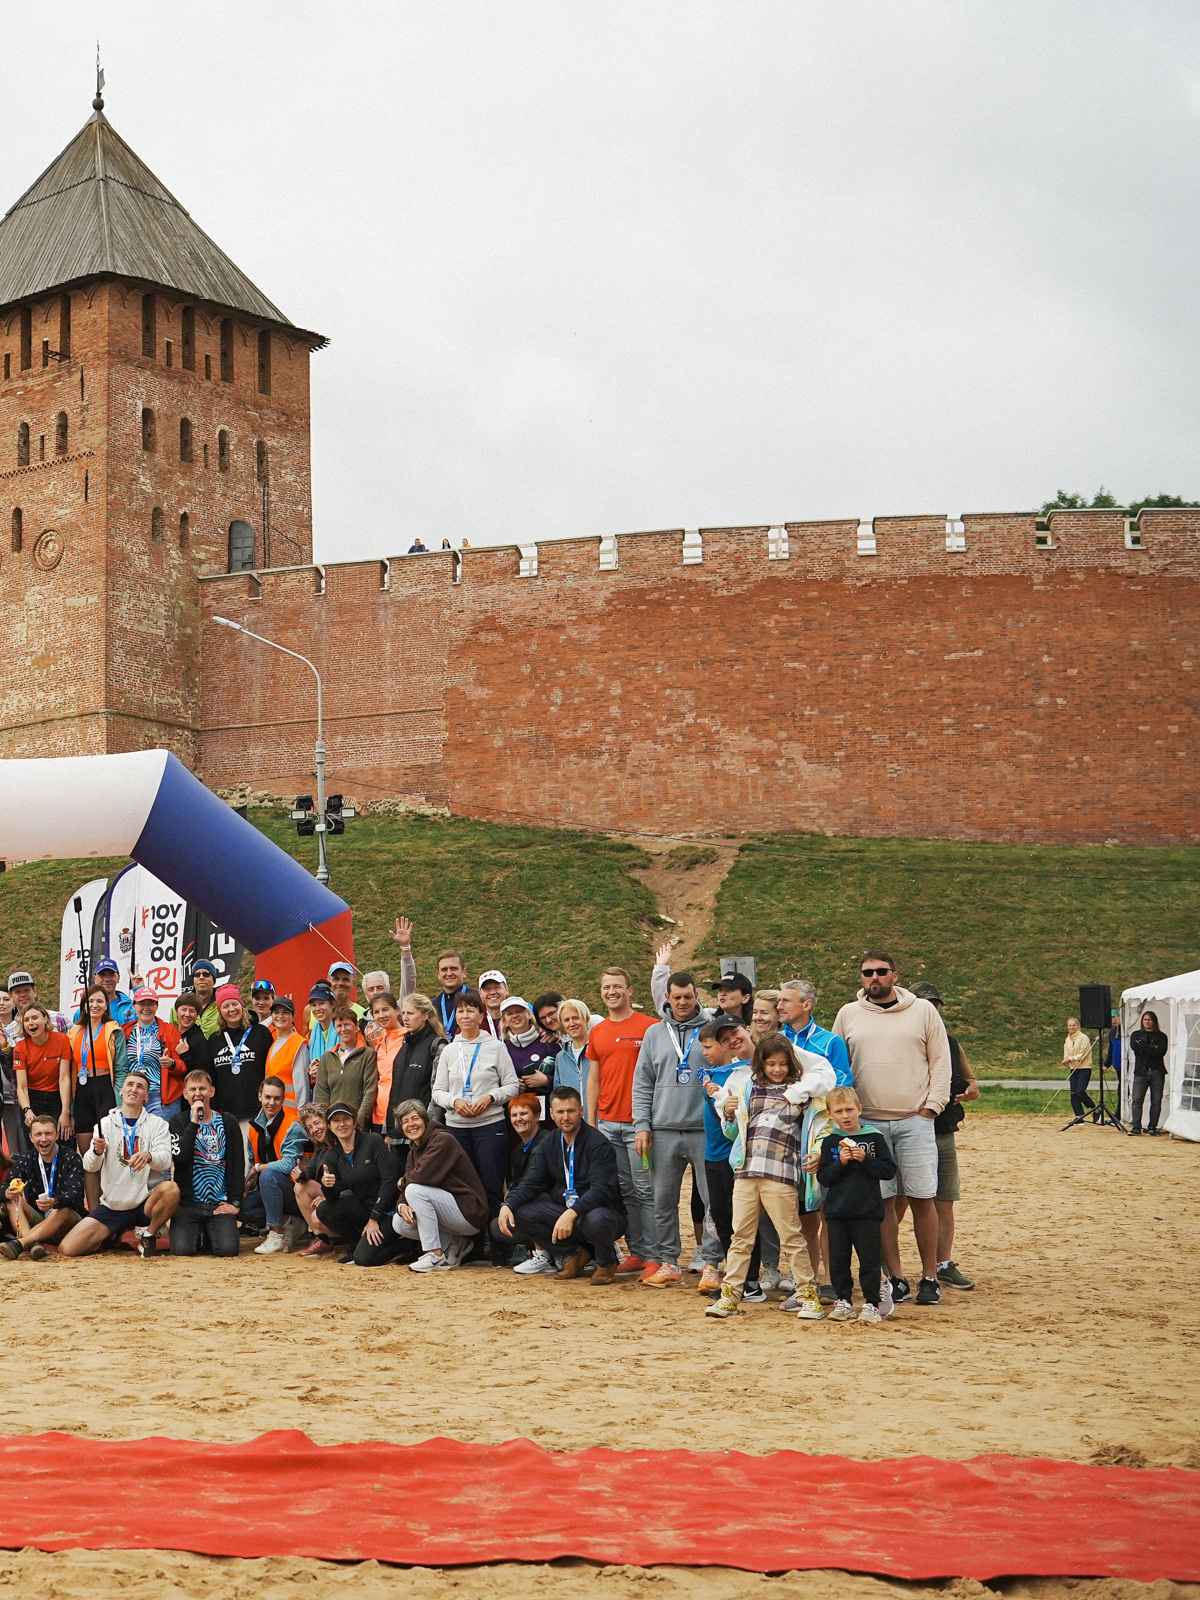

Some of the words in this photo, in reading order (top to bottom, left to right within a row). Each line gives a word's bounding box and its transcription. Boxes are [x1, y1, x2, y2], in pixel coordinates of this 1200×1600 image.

[152, 921, 179, 945] go
[150, 937, 178, 962] od
[12, 975, 29, 984] PUMA
[213, 1051, 256, 1065] FUNCRVE
